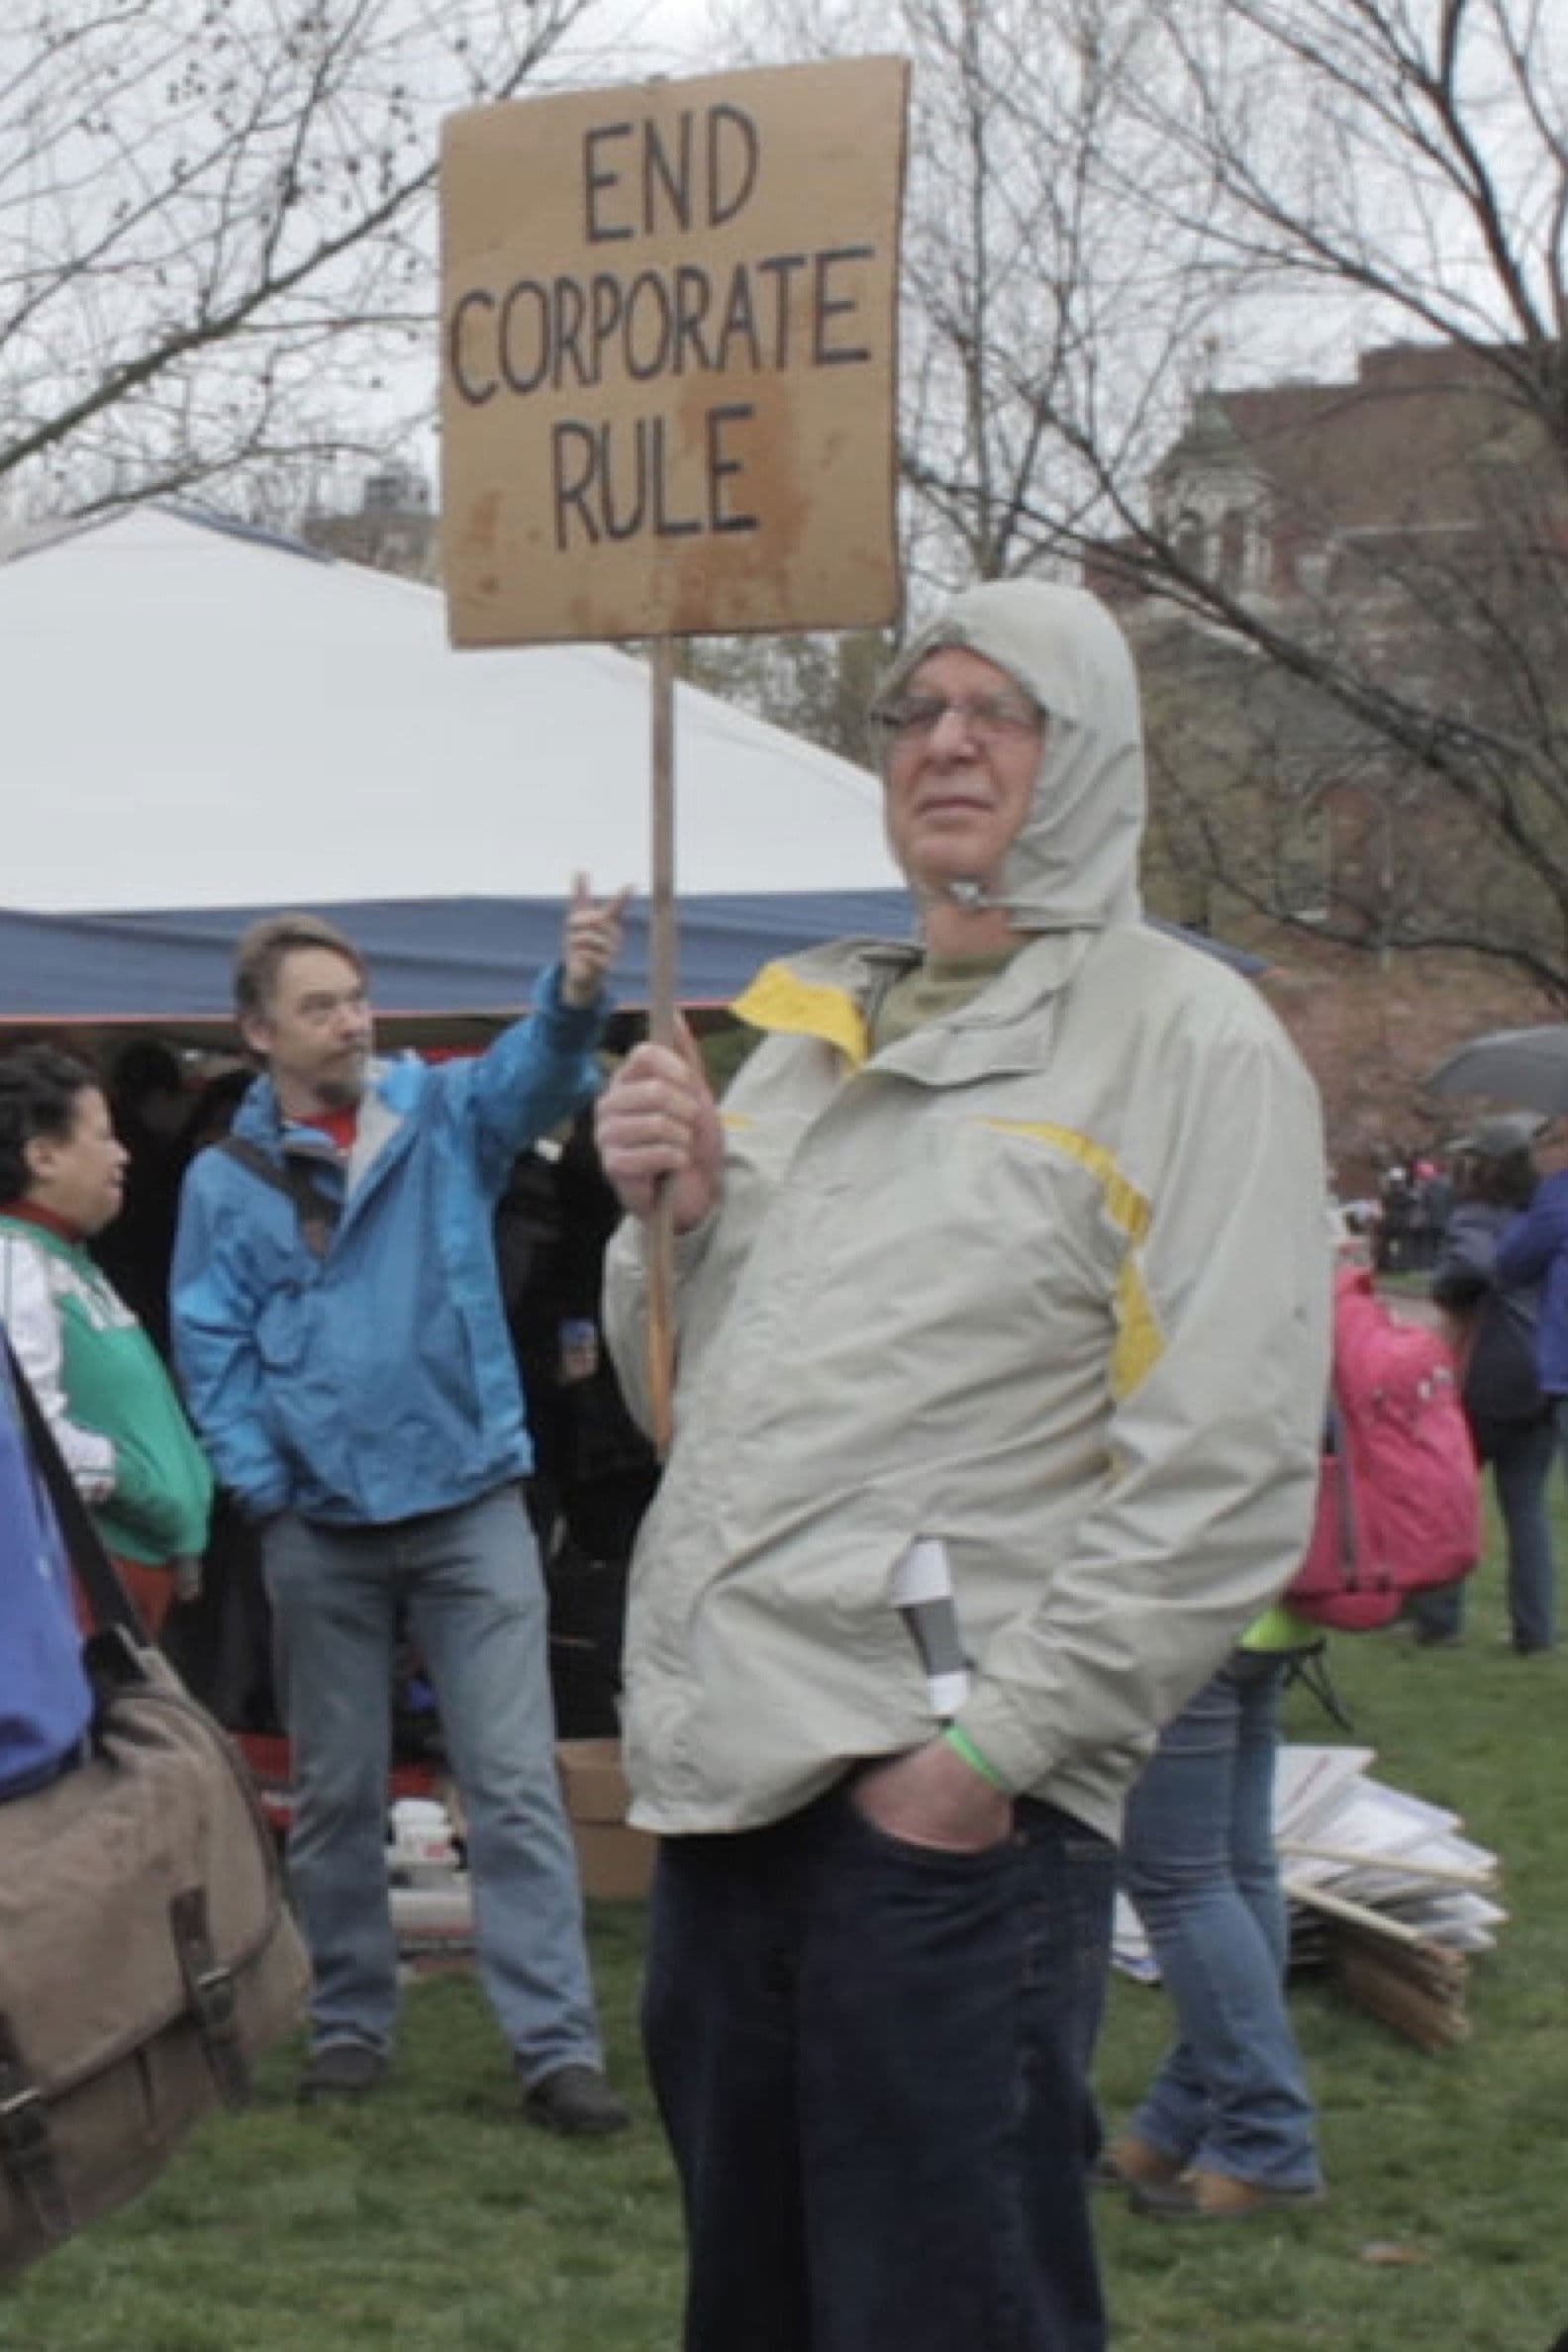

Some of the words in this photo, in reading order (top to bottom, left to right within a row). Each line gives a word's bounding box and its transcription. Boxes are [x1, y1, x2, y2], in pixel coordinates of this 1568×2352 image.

[584, 104, 758, 244] END
[450, 246, 875, 406] CORPORATE
[551, 404, 759, 550] RULE
